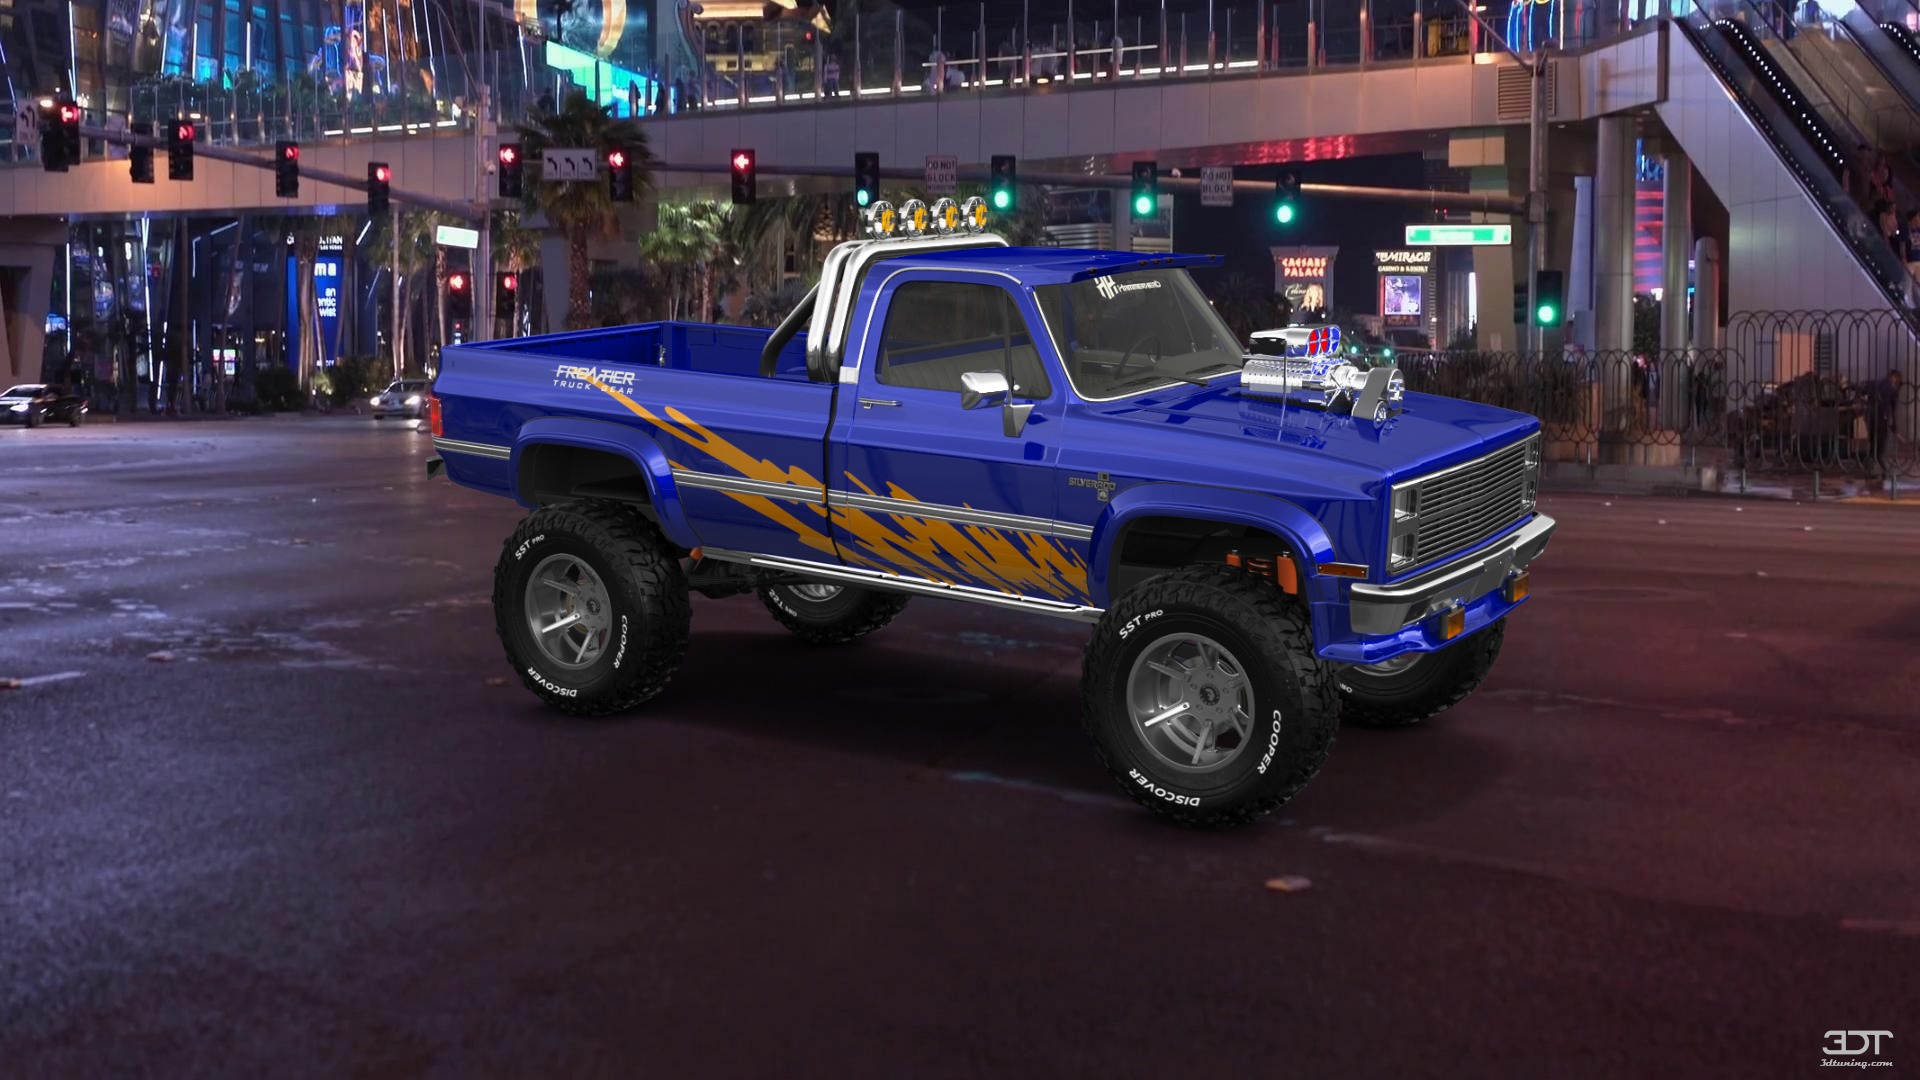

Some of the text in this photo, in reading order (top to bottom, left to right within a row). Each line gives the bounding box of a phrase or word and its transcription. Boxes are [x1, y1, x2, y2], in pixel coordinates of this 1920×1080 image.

[1282, 257, 1327, 267] CAESARS
[1381, 252, 1431, 263] MIRAGE
[1284, 267, 1324, 278] PALACE
[553, 380, 634, 395] TRUCK GEAR
[556, 365, 636, 386] FRONTIER
[515, 534, 545, 560] SST PRO
[1119, 609, 1164, 639] SST PRO
[613, 614, 628, 669] COOPER
[527, 666, 578, 698] DISCOVER
[1256, 709, 1282, 775] COOPER
[1128, 768, 1201, 807] DISCOVER
